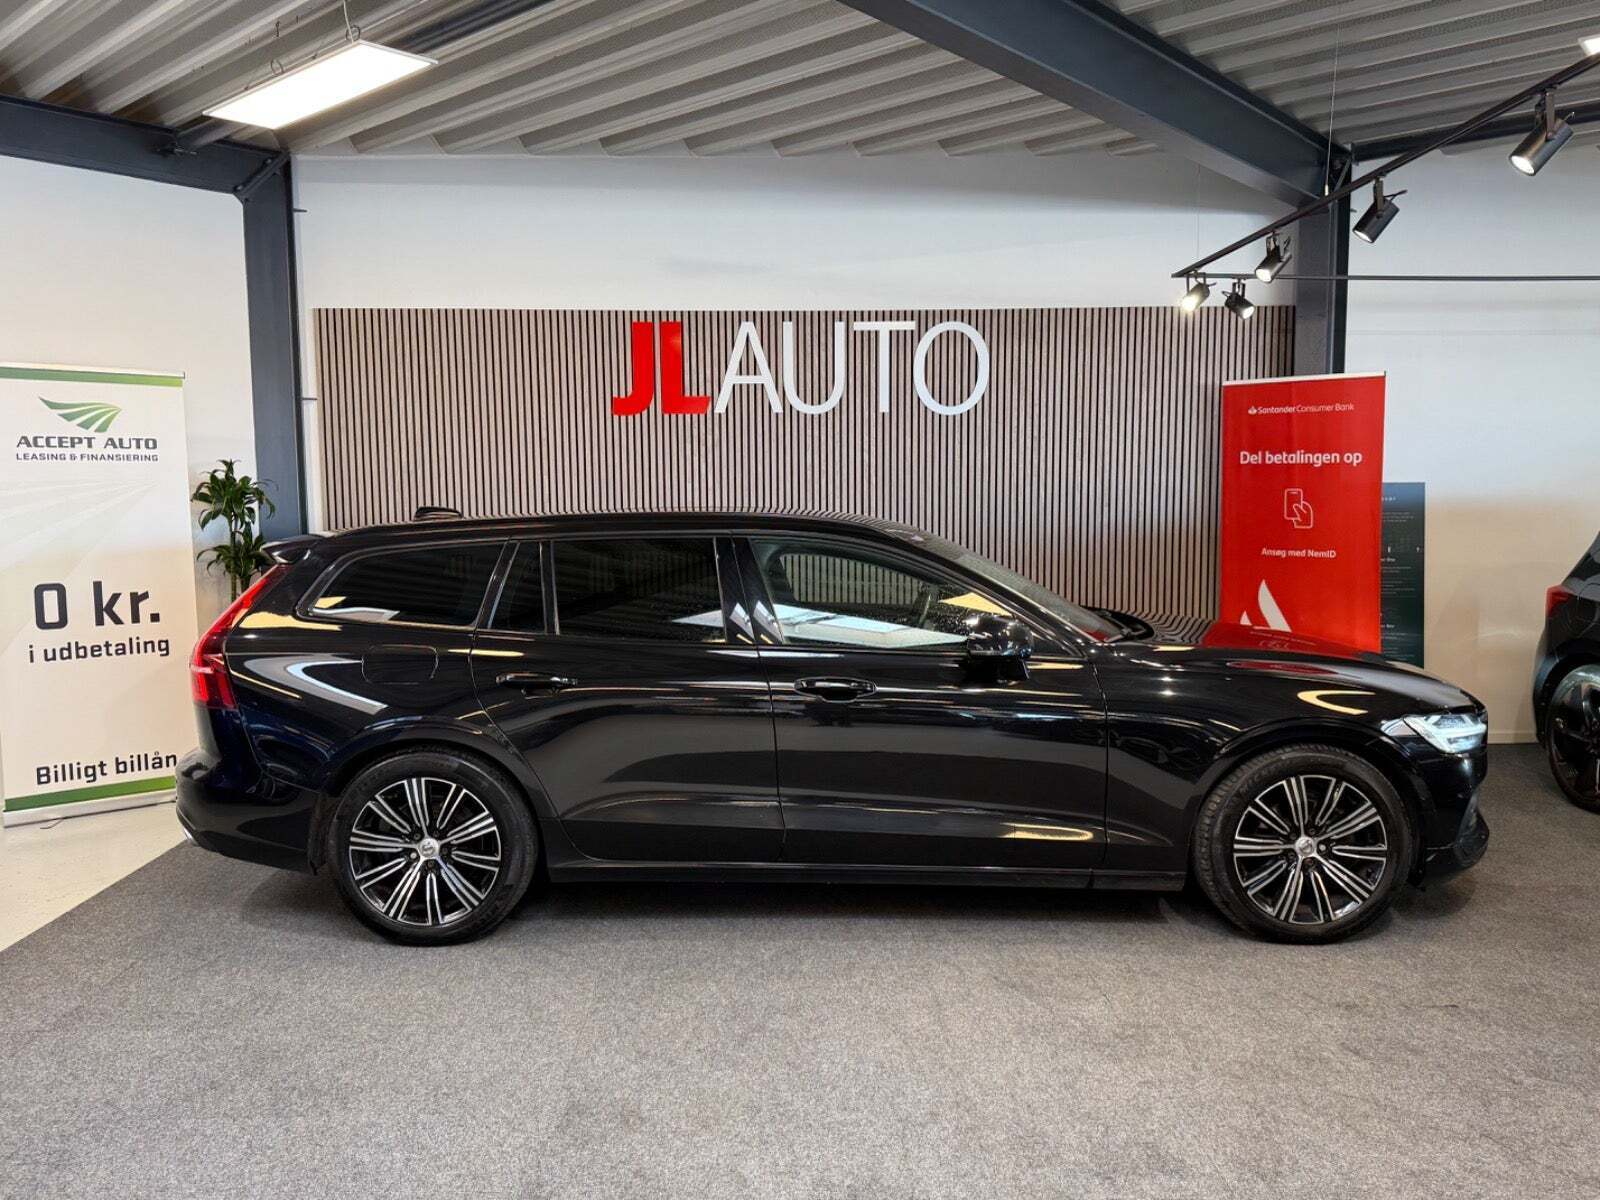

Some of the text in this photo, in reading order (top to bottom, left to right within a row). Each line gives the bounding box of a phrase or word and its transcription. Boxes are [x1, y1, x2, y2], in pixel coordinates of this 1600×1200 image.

[714, 321, 990, 416] AUTO
[1335, 402, 1355, 412] Bank
[16, 435, 158, 450] ACCEPT AUTO
[16, 453, 159, 462] LEASING & FINANSIERING
[1239, 450, 1363, 467] Del betalingen op
[1261, 547, 1337, 558] Ansøg med NemID
[34, 580, 161, 631] 0 kr.
[28, 636, 170, 664] i udbetaling
[36, 751, 177, 786] Billigt billån
